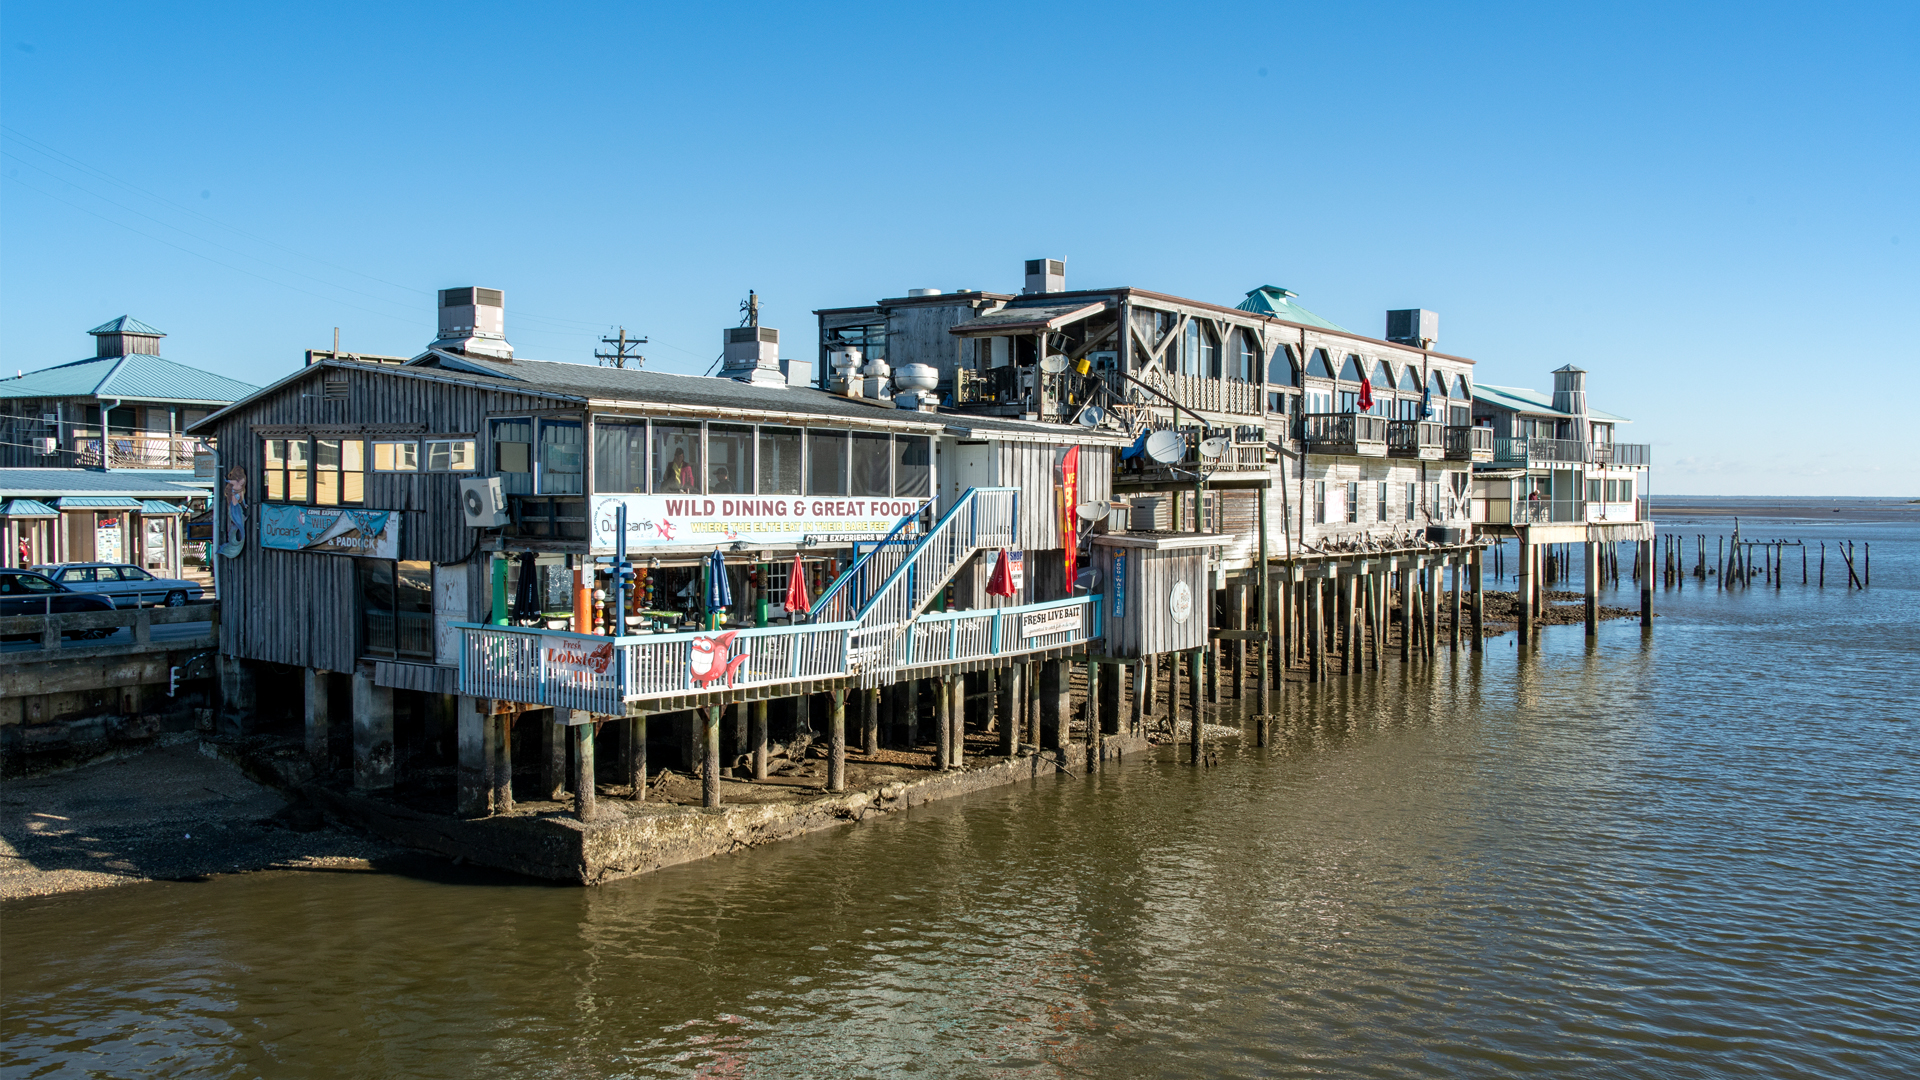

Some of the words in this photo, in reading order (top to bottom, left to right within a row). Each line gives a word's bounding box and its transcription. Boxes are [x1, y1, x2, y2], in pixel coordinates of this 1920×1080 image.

[666, 500, 715, 516] WILD
[722, 500, 787, 516] DINING
[793, 501, 806, 516] &
[812, 501, 865, 516] GREAT
[870, 501, 916, 517] FOOD!
[311, 517, 333, 530] WILD
[602, 518, 653, 532] Ducan's
[690, 522, 728, 533] WHERE
[730, 522, 751, 532] THE
[753, 522, 781, 532] ELITE
[783, 522, 801, 532] EAT
[803, 521, 813, 531] IN
[815, 521, 843, 531] THEIR
[844, 521, 868, 531] BARE
[869, 521, 890, 531] FEET
[336, 537, 375, 549] PADDOCK
[829, 534, 875, 542] EXPERIENCE
[1010, 551, 1023, 560] SHOP
[1010, 561, 1023, 571] OPEN
[1023, 613, 1047, 626] FRESH
[1047, 609, 1063, 621] LIVE
[1064, 607, 1080, 617] BAIT
[563, 640, 582, 650] Fresh
[547, 648, 603, 669] Lobster
